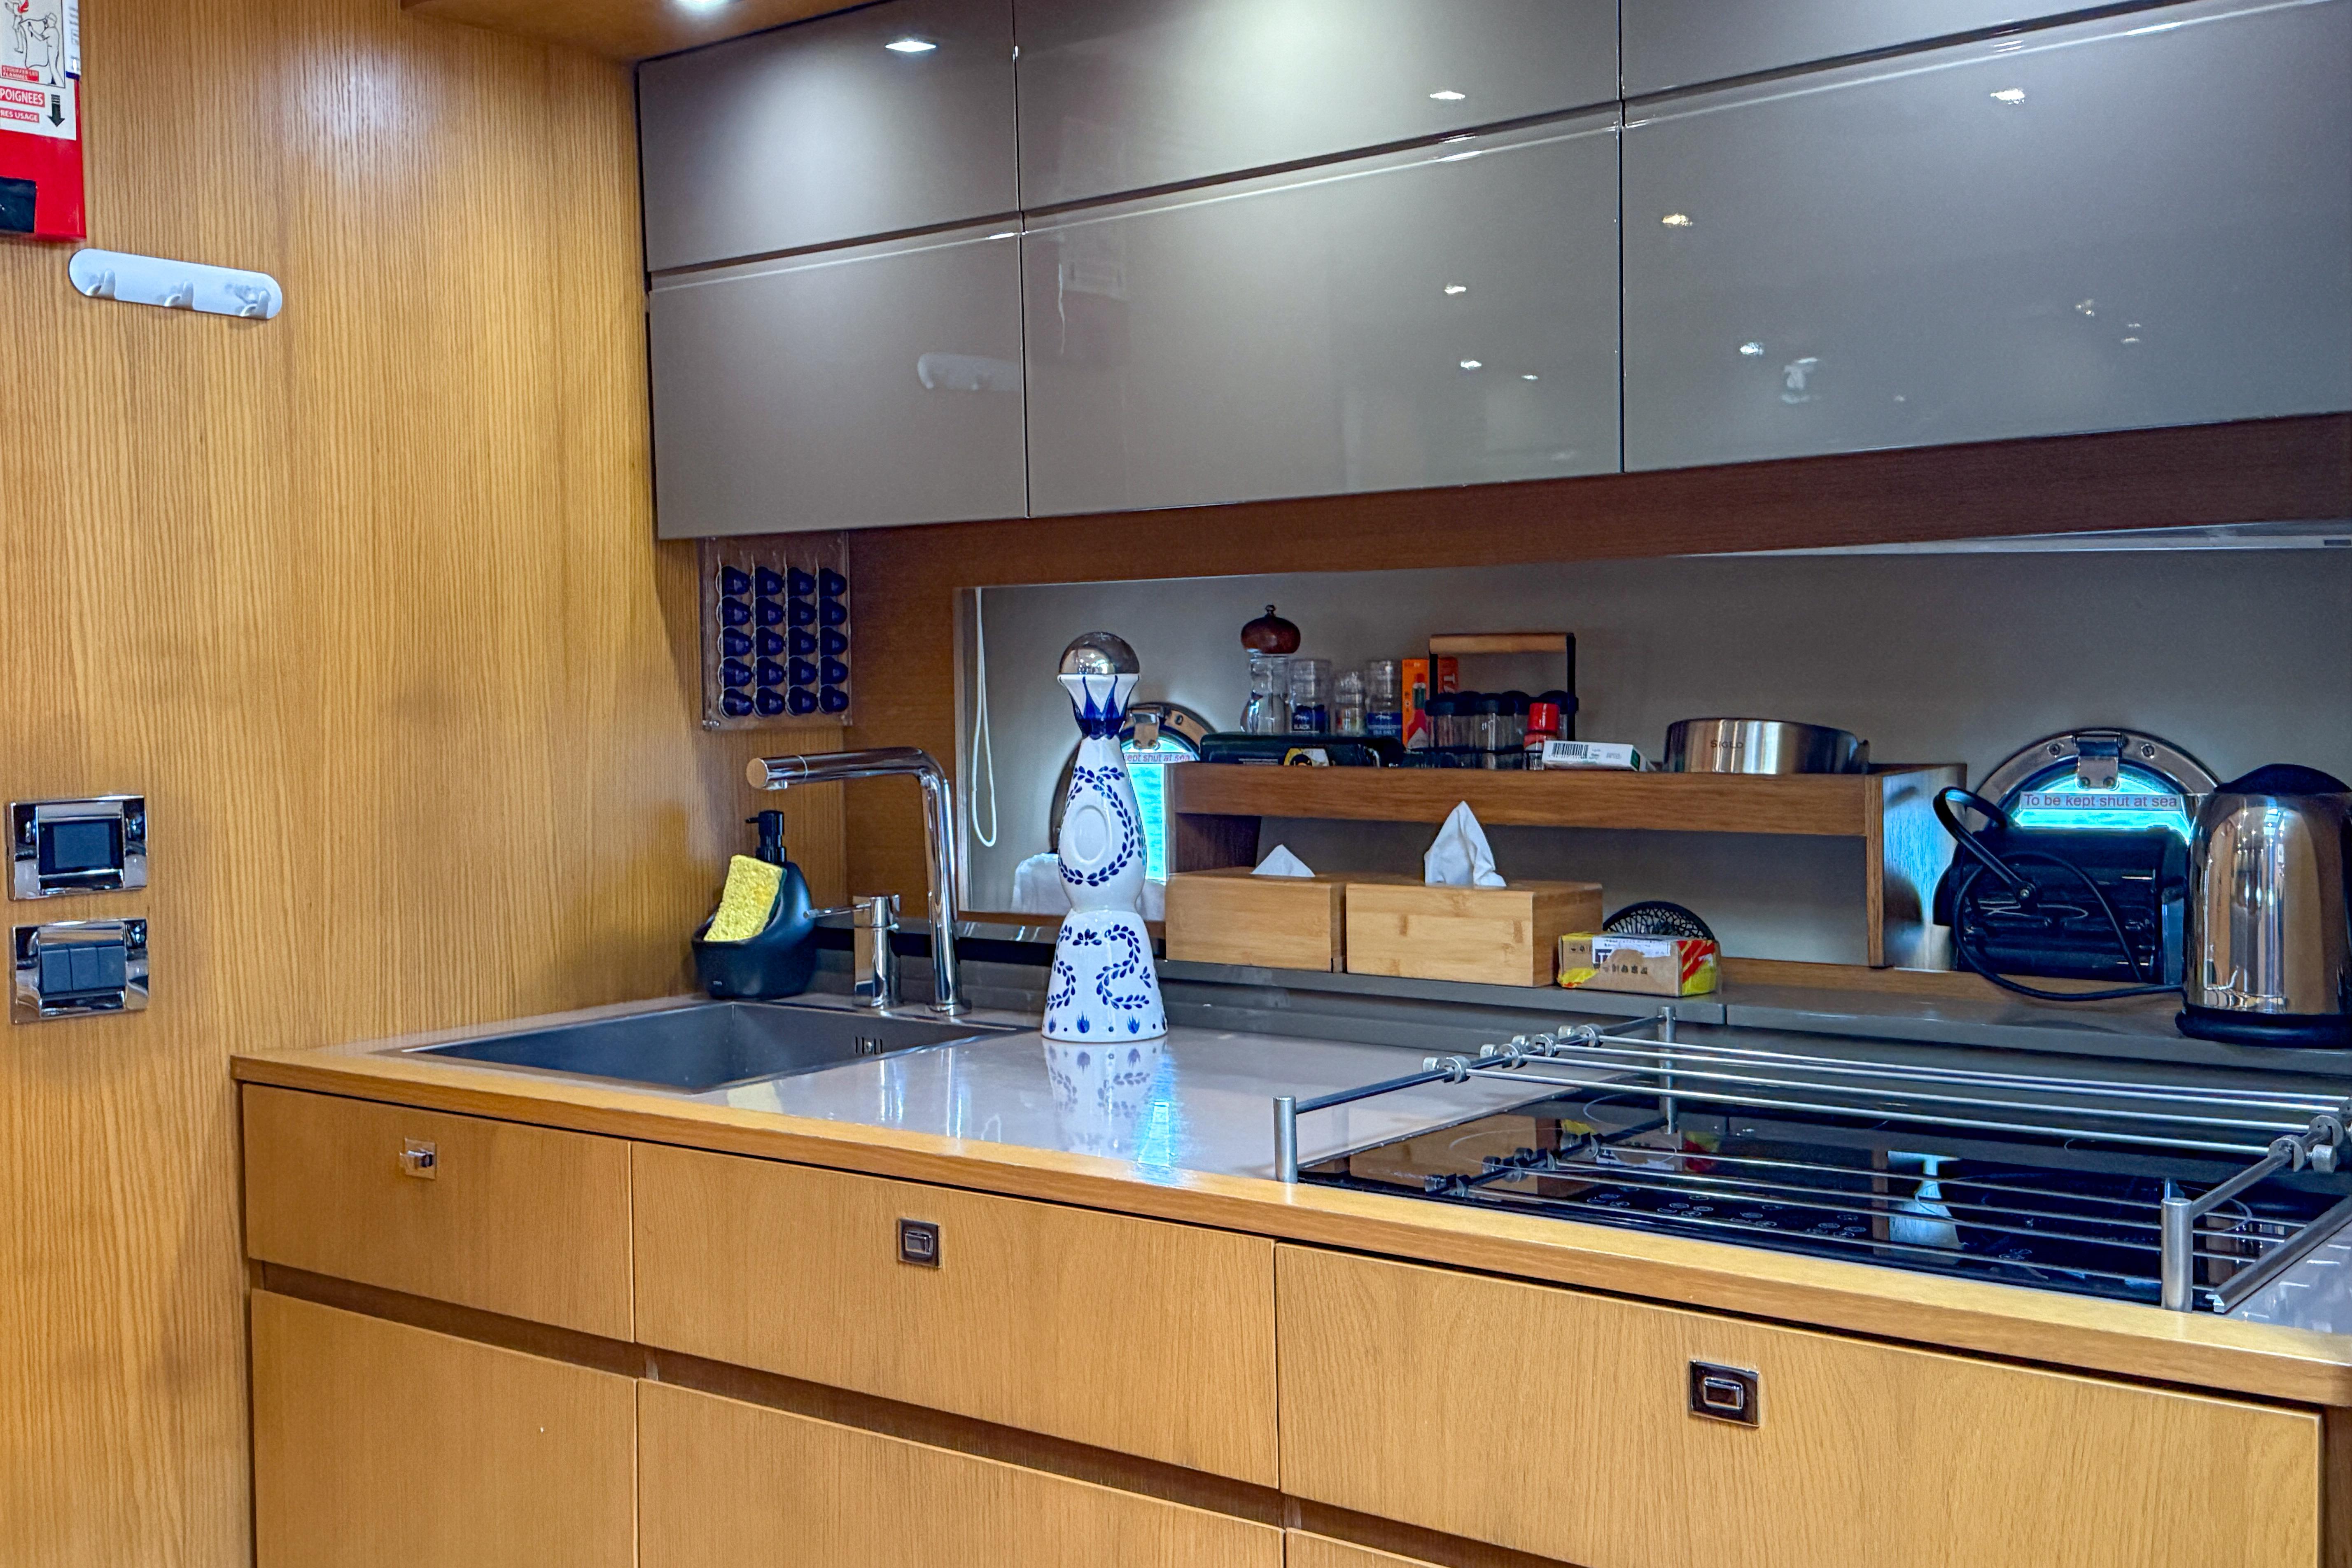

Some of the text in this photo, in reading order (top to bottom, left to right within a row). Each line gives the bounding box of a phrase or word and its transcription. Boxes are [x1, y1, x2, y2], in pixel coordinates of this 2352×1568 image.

[0, 88, 43, 105] POIGNEES
[0, 109, 38, 121] RES USAGE
[1143, 754, 1162, 762] shut
[2024, 794, 2177, 808] To be kept shut at sea
